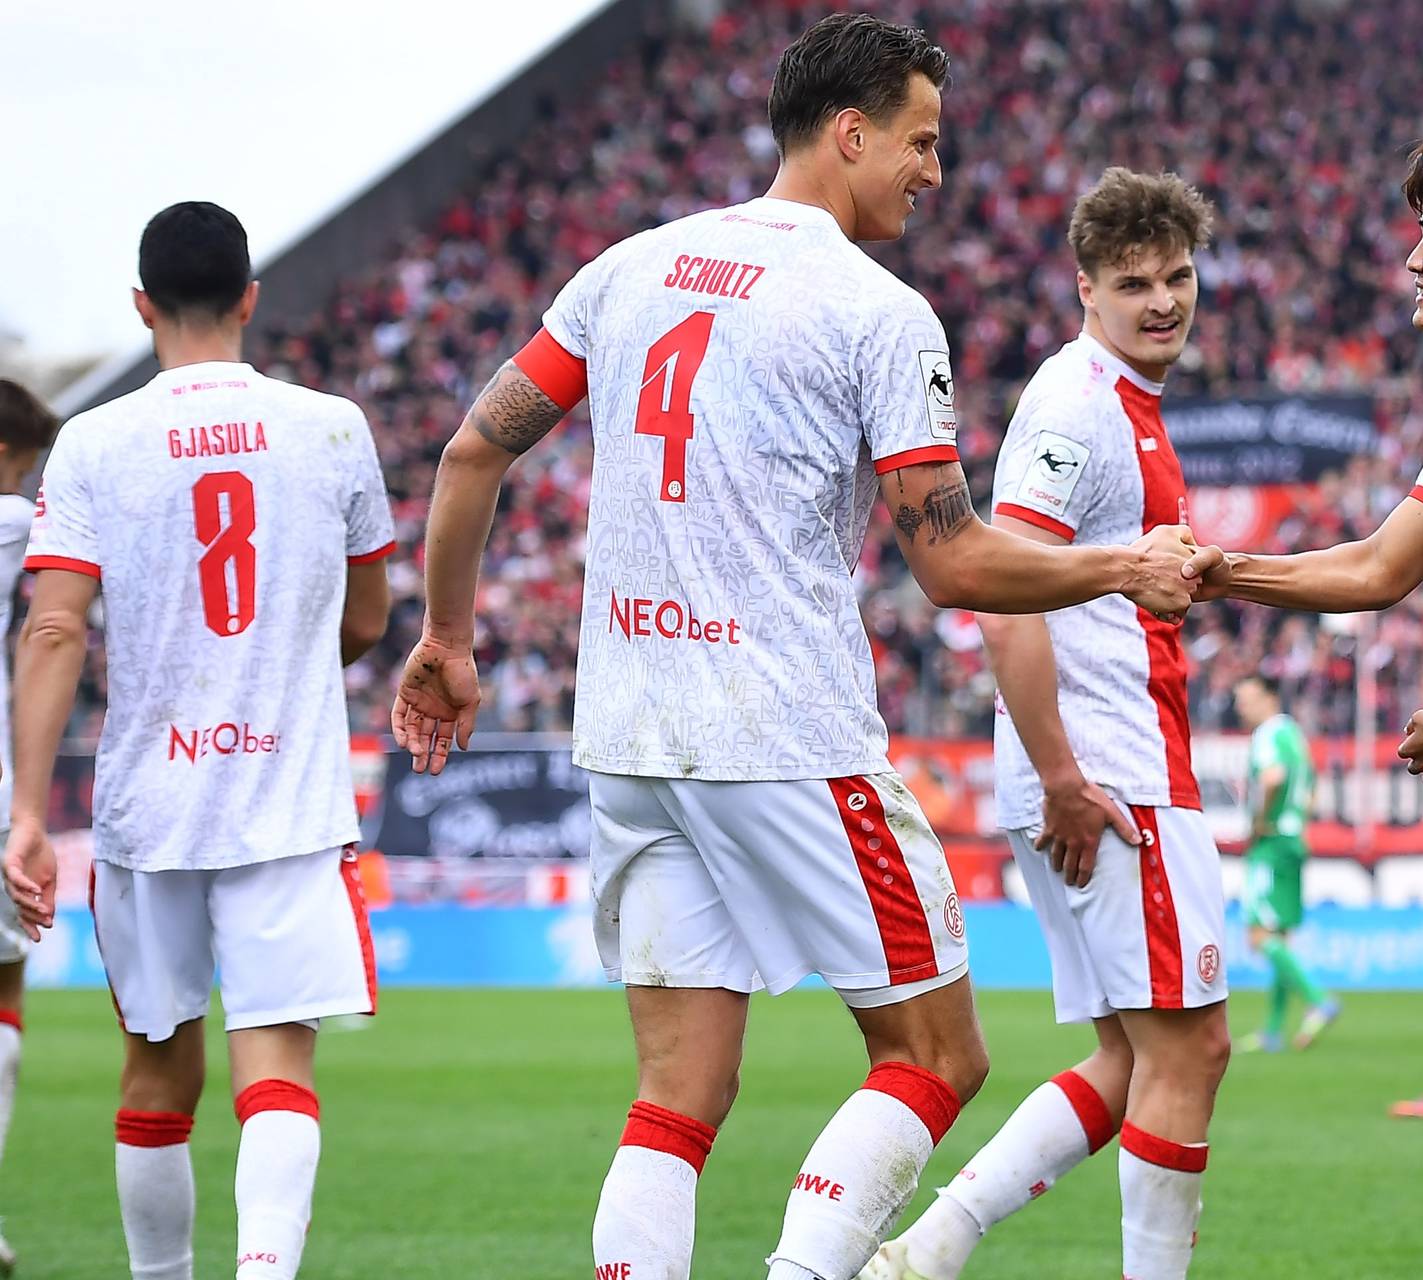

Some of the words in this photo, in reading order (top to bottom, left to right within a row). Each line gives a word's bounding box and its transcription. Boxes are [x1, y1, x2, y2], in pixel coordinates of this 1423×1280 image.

[664, 253, 766, 300] SCHULTZ
[167, 421, 268, 459] GJASULA
[634, 310, 716, 503] 4
[191, 470, 257, 638] 8
